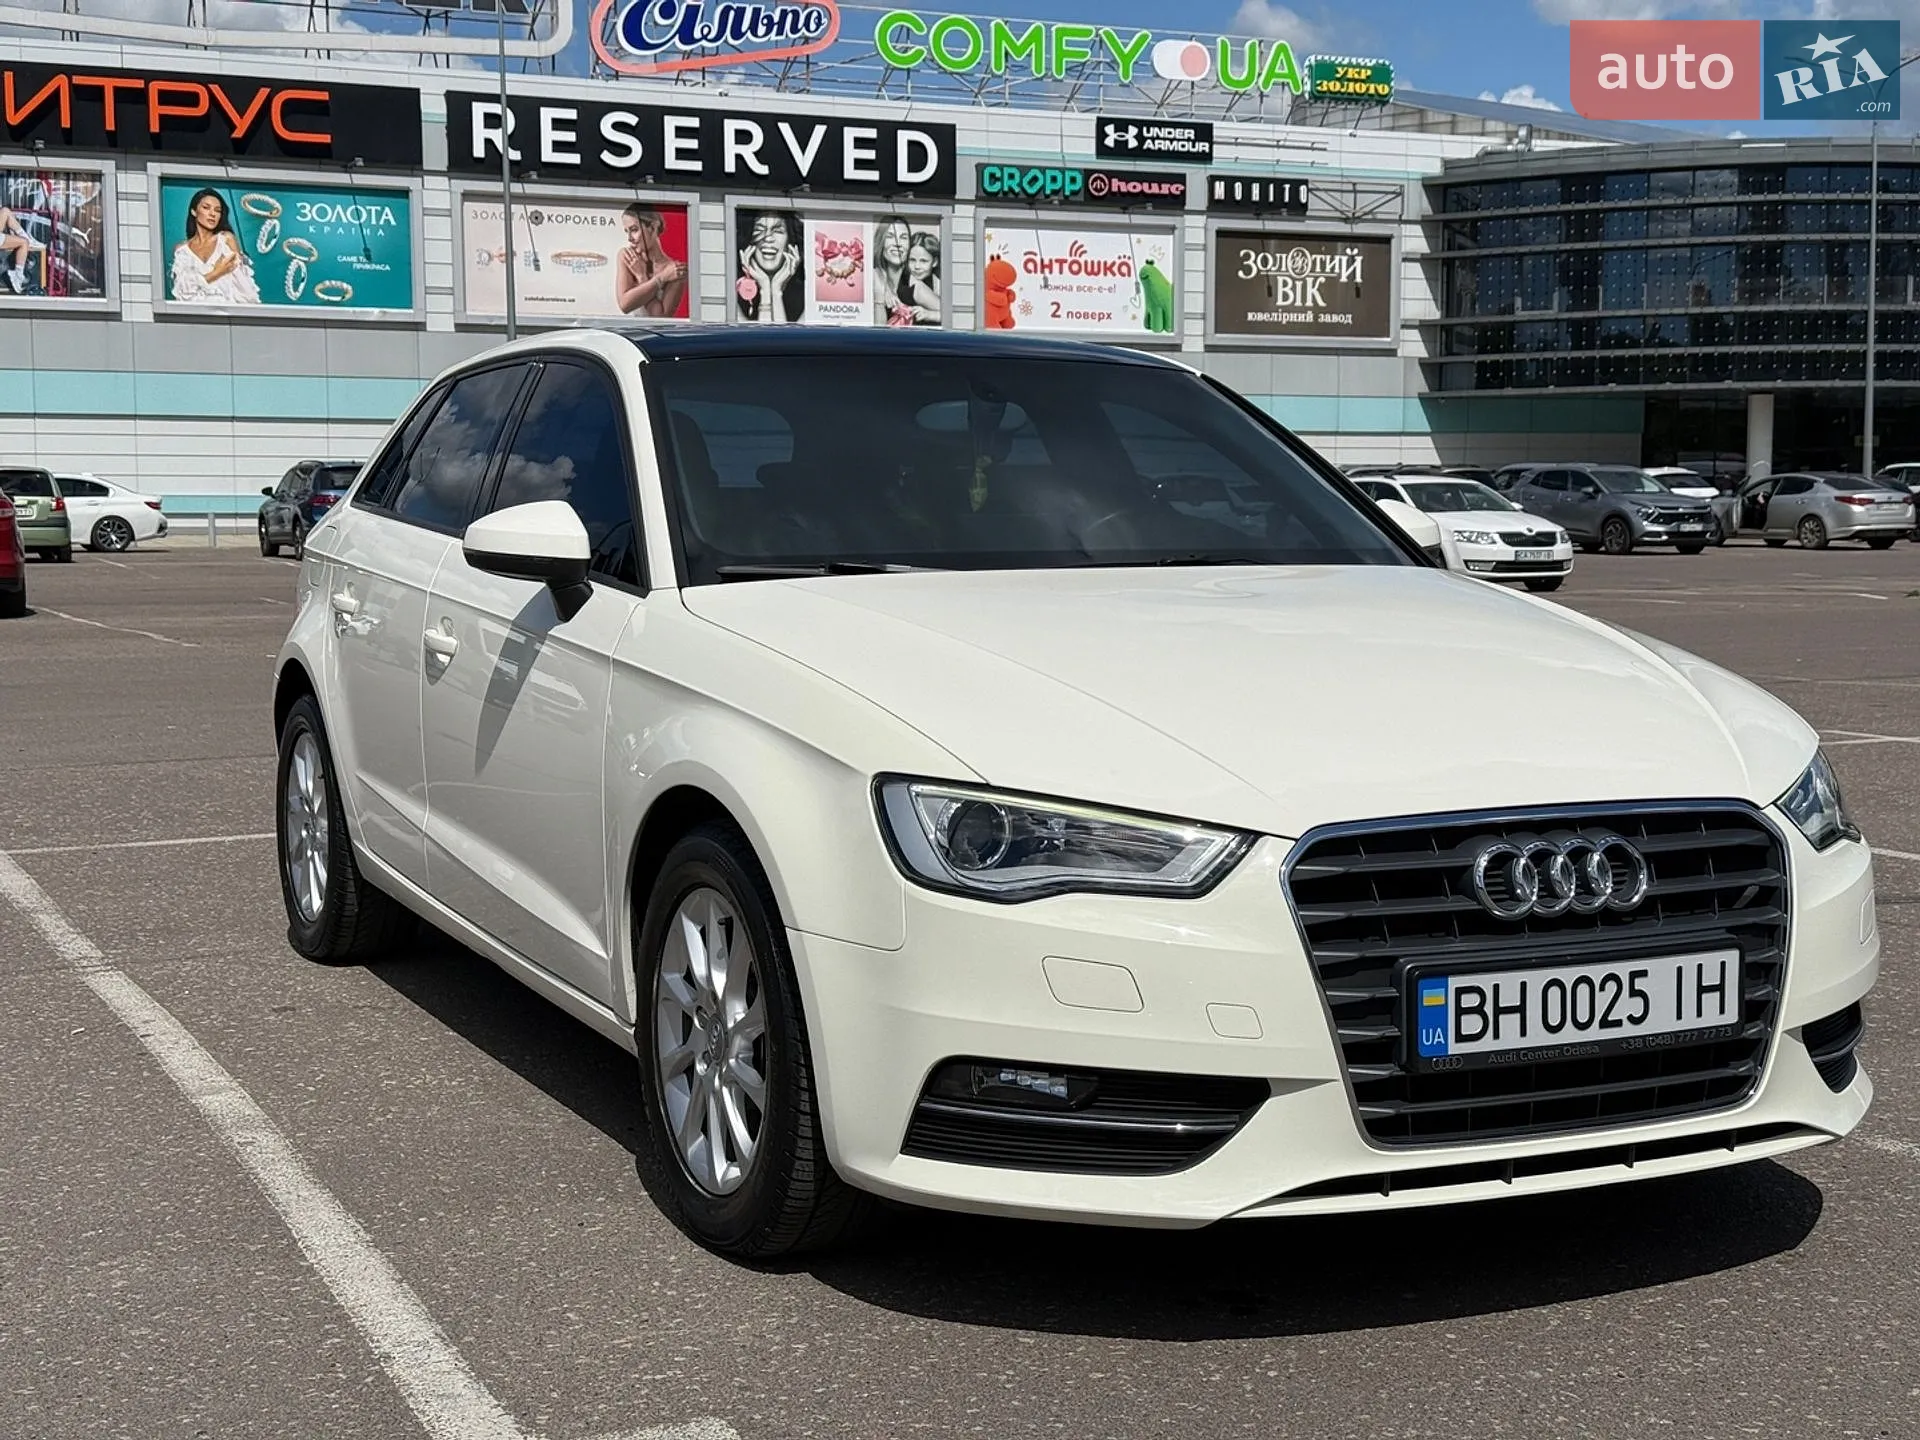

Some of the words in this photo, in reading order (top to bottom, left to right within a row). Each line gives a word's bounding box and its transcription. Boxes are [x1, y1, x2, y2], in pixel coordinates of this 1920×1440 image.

[618, 0, 826, 54] Сільпо
[874, 9, 1152, 83] COMFY
[1216, 37, 1302, 95] UA
[1334, 66, 1372, 80] УКР
[1315, 80, 1390, 96] ЗОЛОТО
[471, 101, 939, 183] RESERVED
[1143, 126, 1195, 140] UNDER
[1143, 138, 1210, 153] ARMOUR
[983, 166, 1083, 196] CROPP
[1110, 178, 1185, 195] house
[1214, 180, 1308, 204] MOHITO
[295, 202, 396, 225] ЗОЛОТА
[546, 214, 616, 226] КОРОЛЕВА
[818, 304, 860, 313] PANDORA
[1050, 301, 1061, 318] 2
[1066, 310, 1112, 322] поверх
[1247, 309, 1314, 324] ювелірний
[1318, 313, 1353, 325] завод
[1454, 981, 1527, 1044] BH
[1541, 969, 1650, 1034] 0025
[1675, 960, 1727, 1021] IH
[1422, 1026, 1445, 1046] UA
[1488, 1051, 1516, 1064] Audi
[1519, 1049, 1560, 1061] Center
[1563, 1045, 1600, 1056] Odesa
[1620, 1037, 1644, 1049] +38
[1645, 1033, 1675, 1048] (048)
[1678, 1031, 1699, 1042] 777
[1703, 1029, 1717, 1039] 77
[1718, 1027, 1733, 1037] 73
